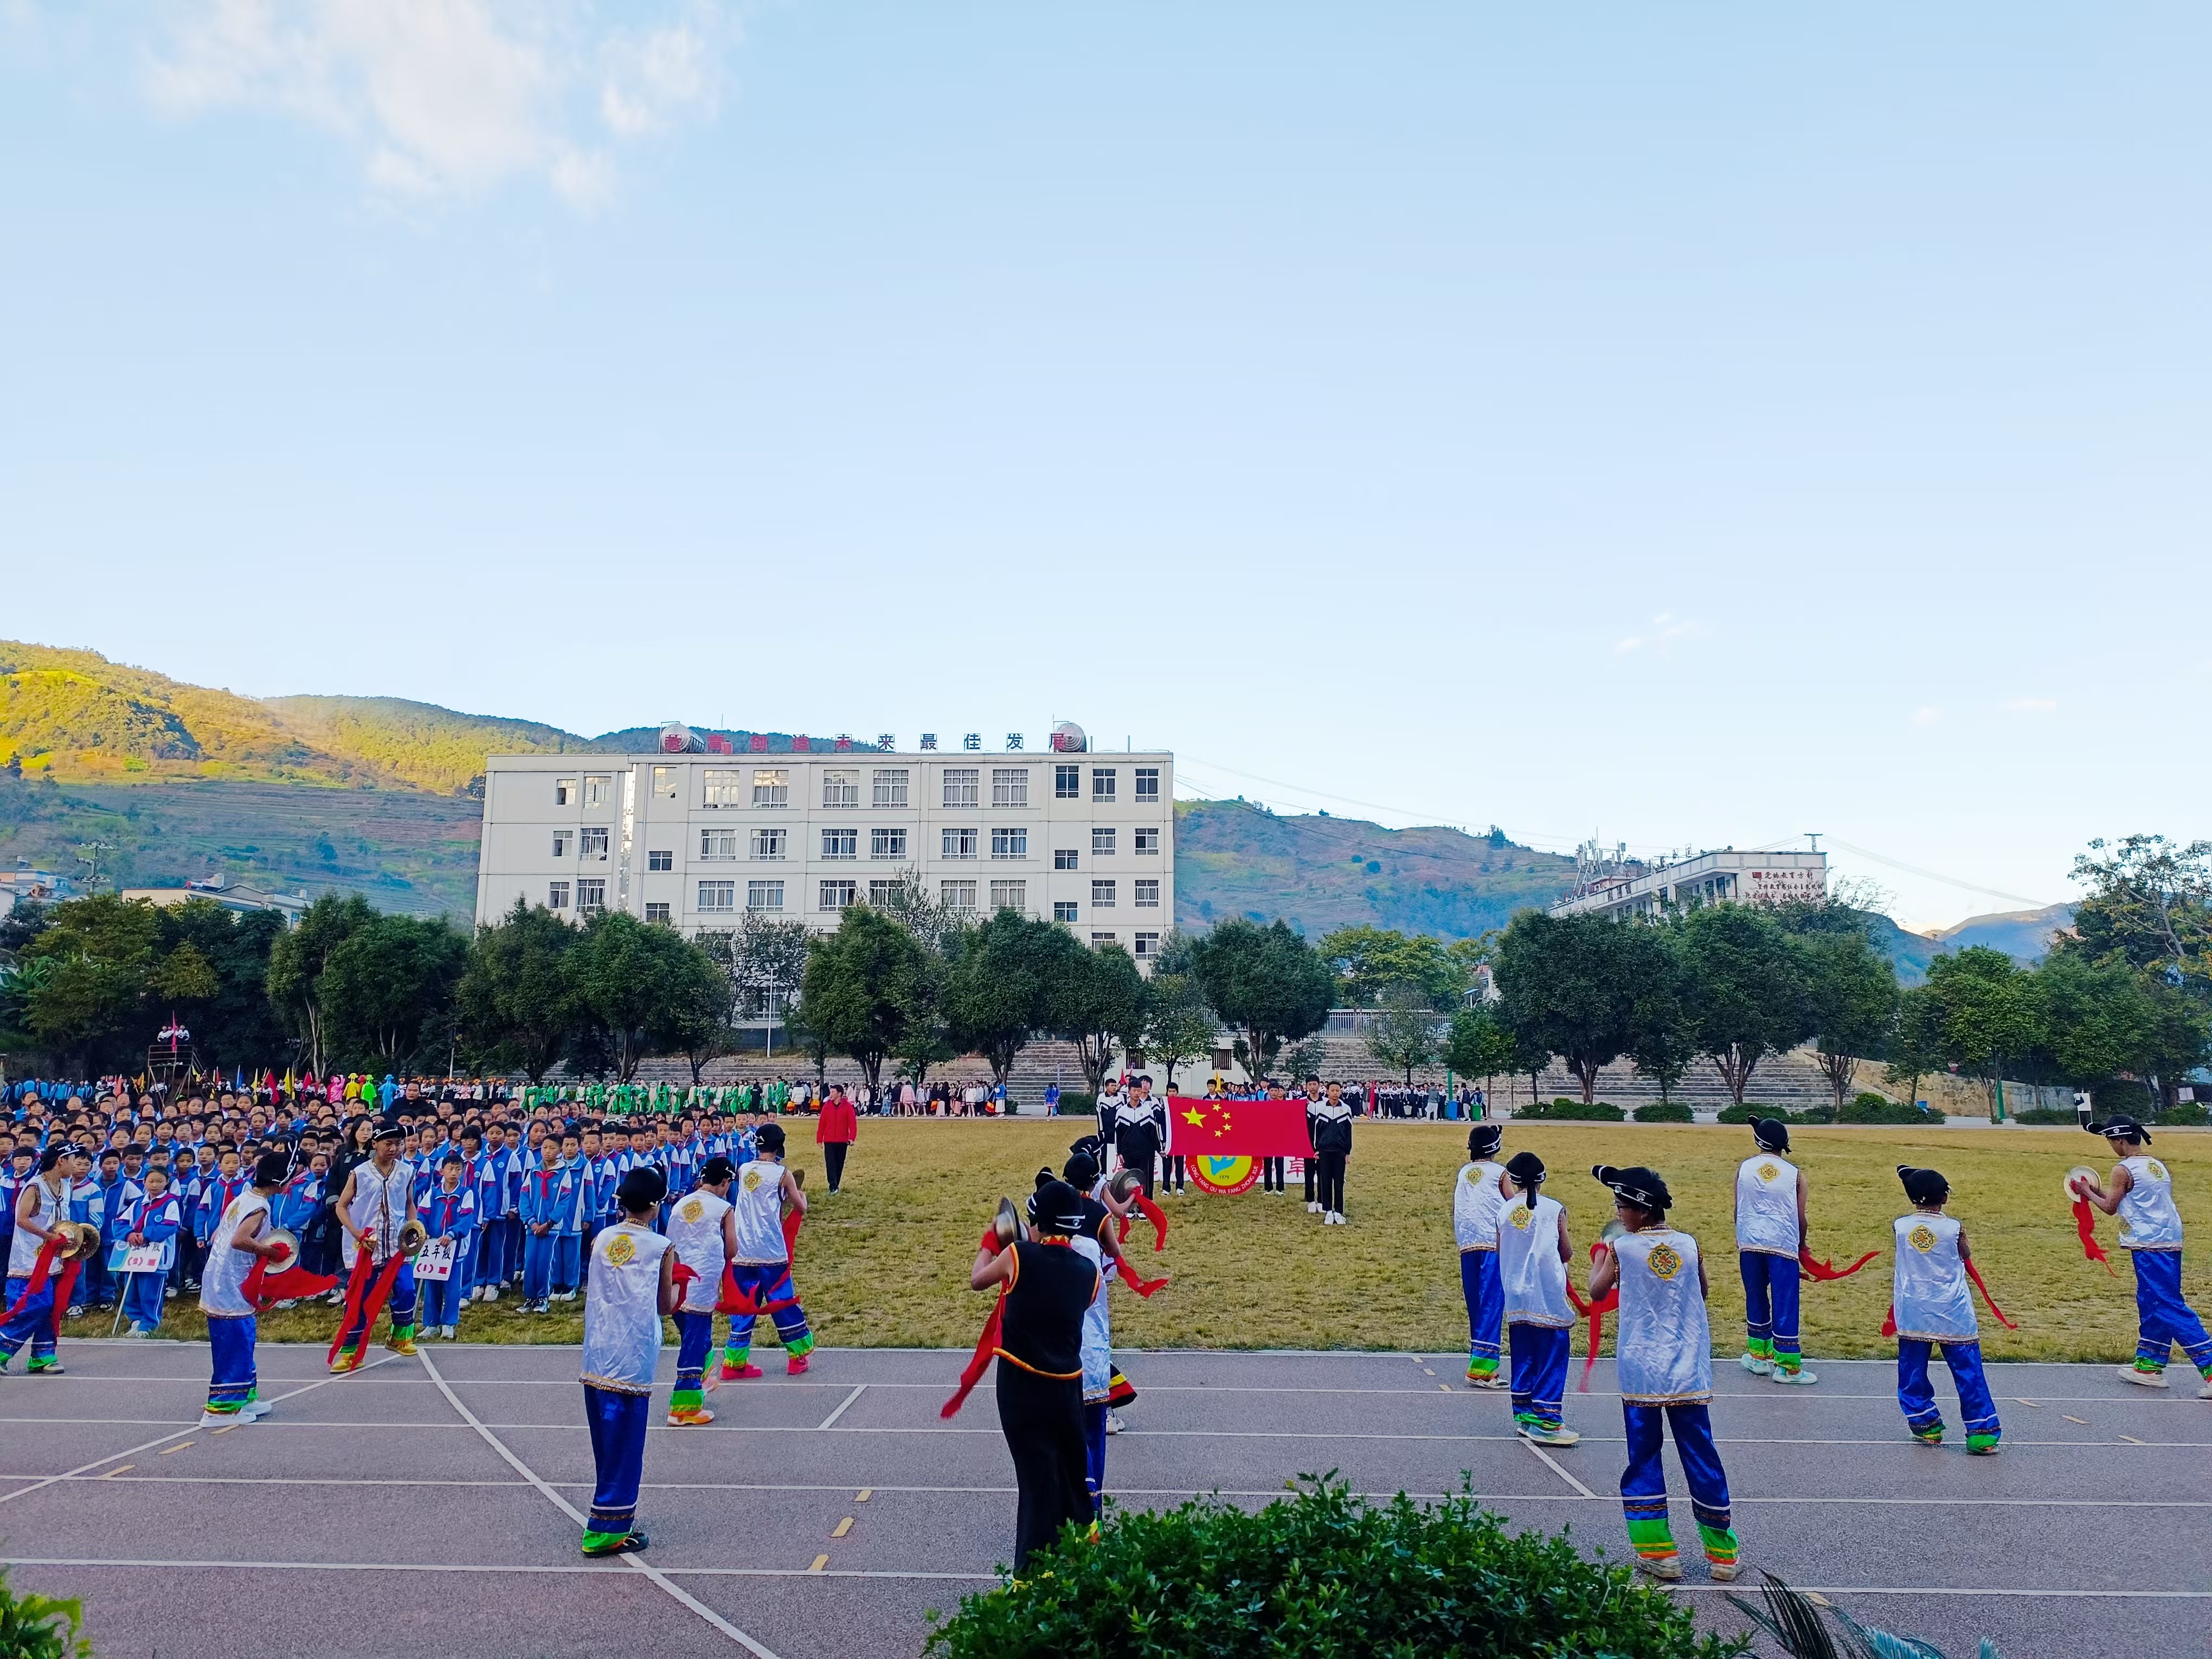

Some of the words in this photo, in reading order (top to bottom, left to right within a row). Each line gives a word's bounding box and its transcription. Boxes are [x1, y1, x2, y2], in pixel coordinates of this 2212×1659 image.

[1191, 1165, 1200, 1178] LONG
[1199, 1177, 1210, 1189] YANG
[1240, 1175, 1255, 1189] ZHONG
[420, 1244, 451, 1261] 五年级
